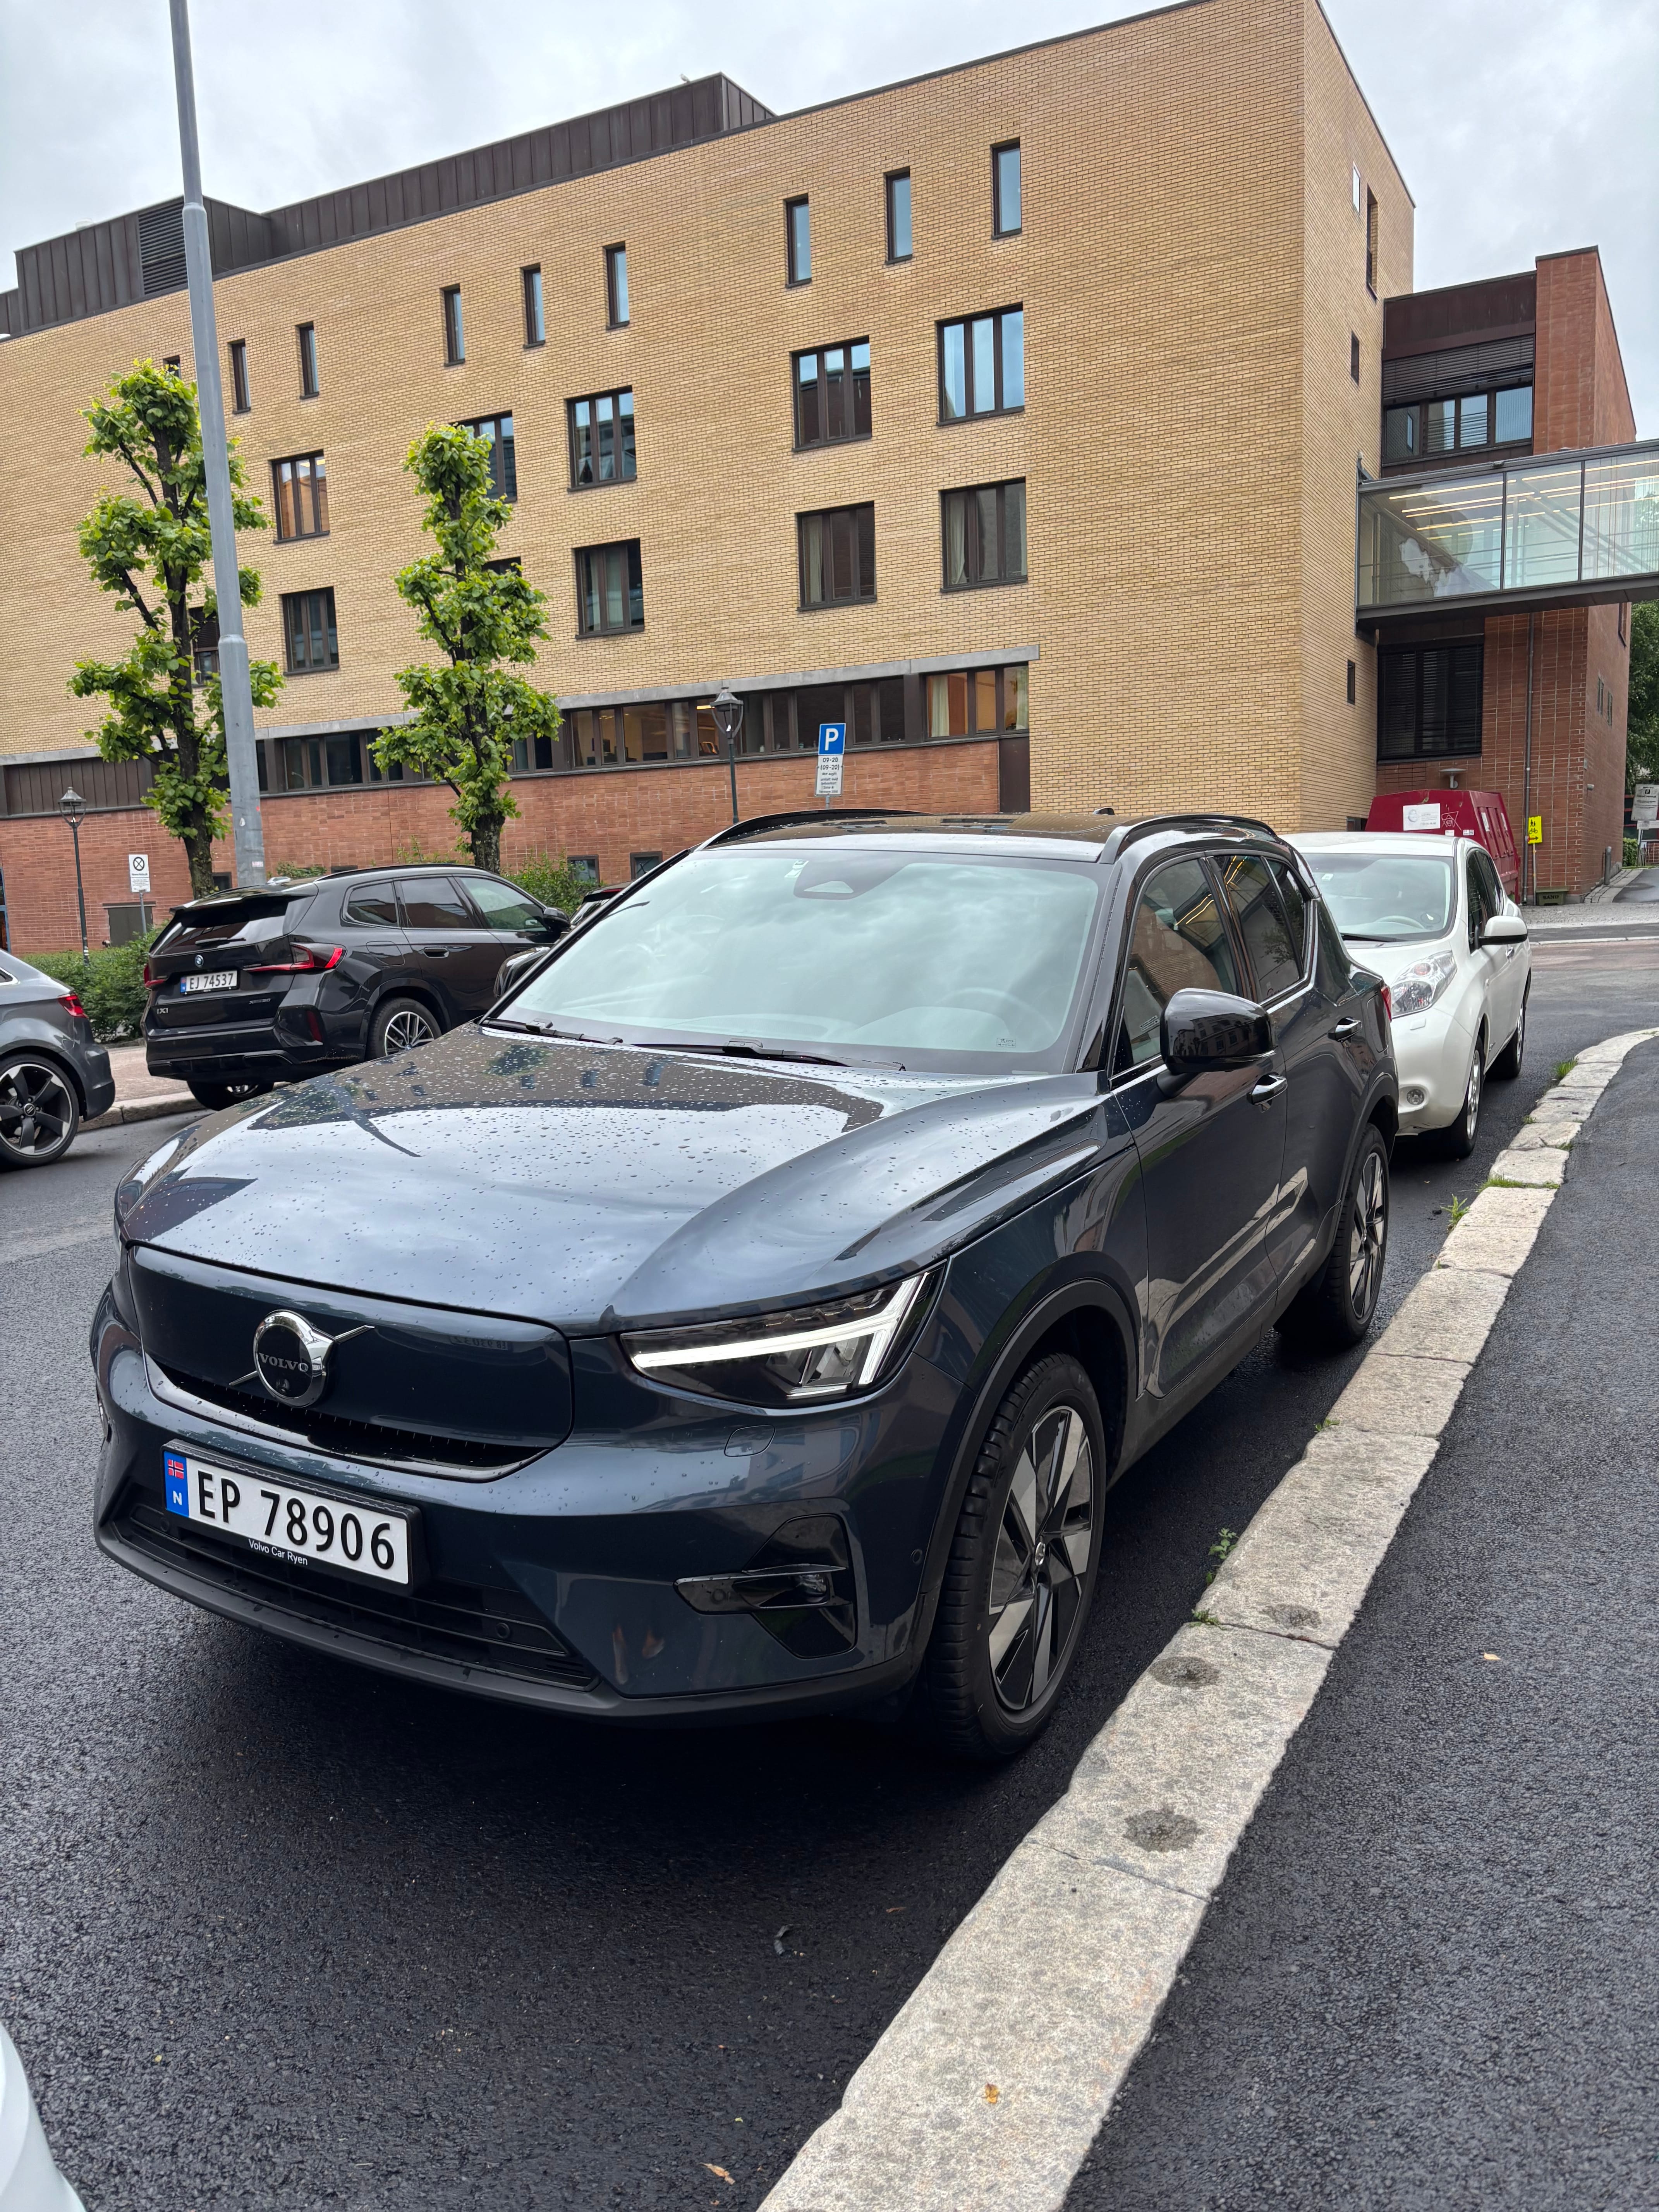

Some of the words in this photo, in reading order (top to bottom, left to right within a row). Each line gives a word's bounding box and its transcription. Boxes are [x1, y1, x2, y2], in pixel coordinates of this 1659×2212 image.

[824, 728, 839, 750] P
[190, 978, 199, 989] EJ
[204, 973, 234, 988] 74537
[259, 1352, 309, 1372] VOLVO
[173, 1491, 182, 1506] N
[198, 1470, 240, 1523] EP
[260, 1489, 395, 1570] 78906
[248, 1539, 269, 1553] Volvo
[271, 1546, 285, 1558] Car
[287, 1551, 308, 1565] Ryen
